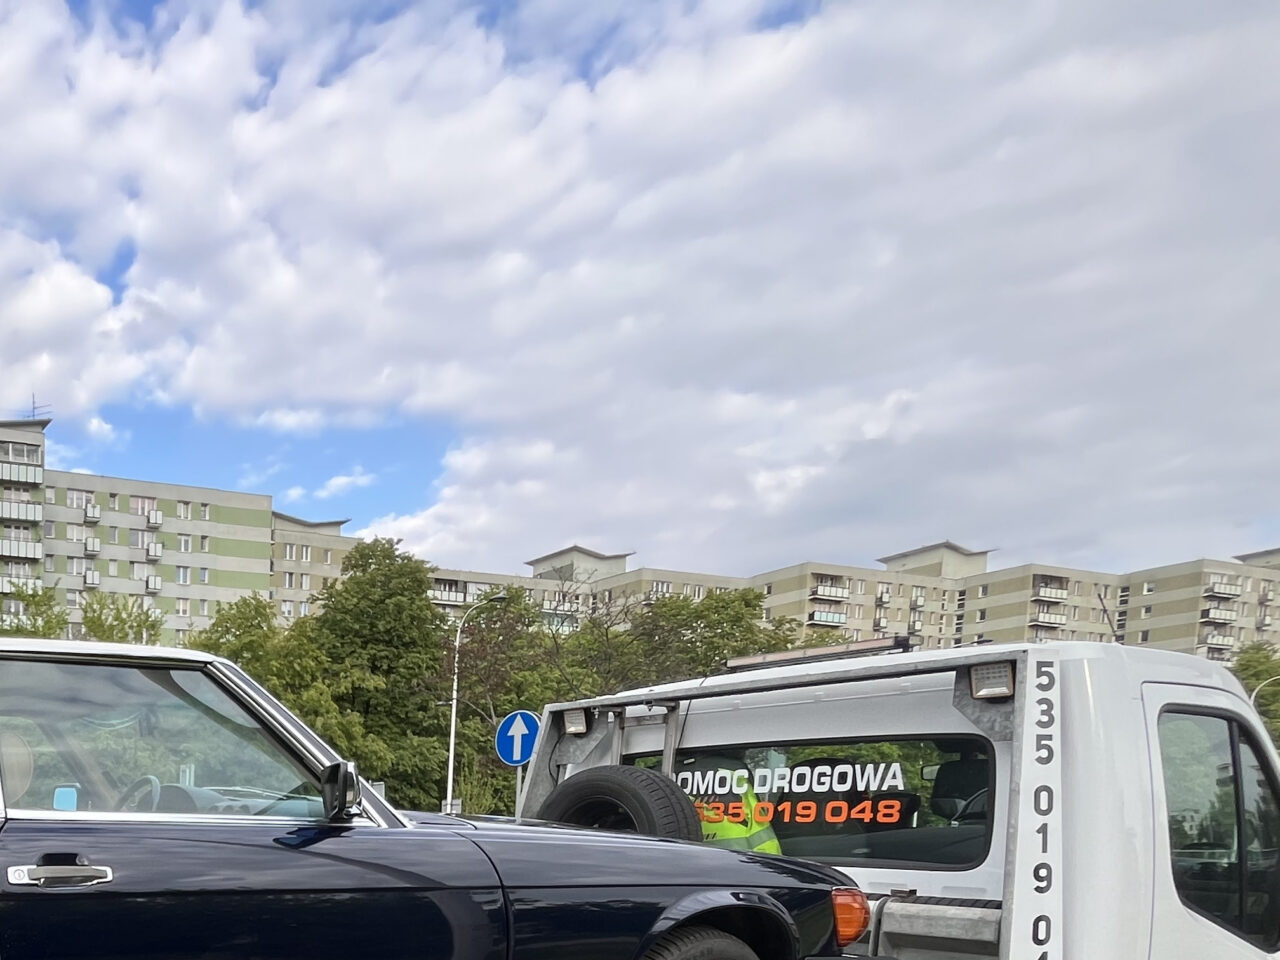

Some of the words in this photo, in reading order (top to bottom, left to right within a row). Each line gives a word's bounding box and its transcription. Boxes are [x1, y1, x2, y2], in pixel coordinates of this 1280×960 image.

[1033, 660, 1055, 765] 535
[673, 769, 749, 795] OMOC
[753, 762, 905, 794] DROGOWA
[753, 801, 817, 823] 019
[825, 800, 901, 823] 048
[1033, 785, 1054, 894] 019
